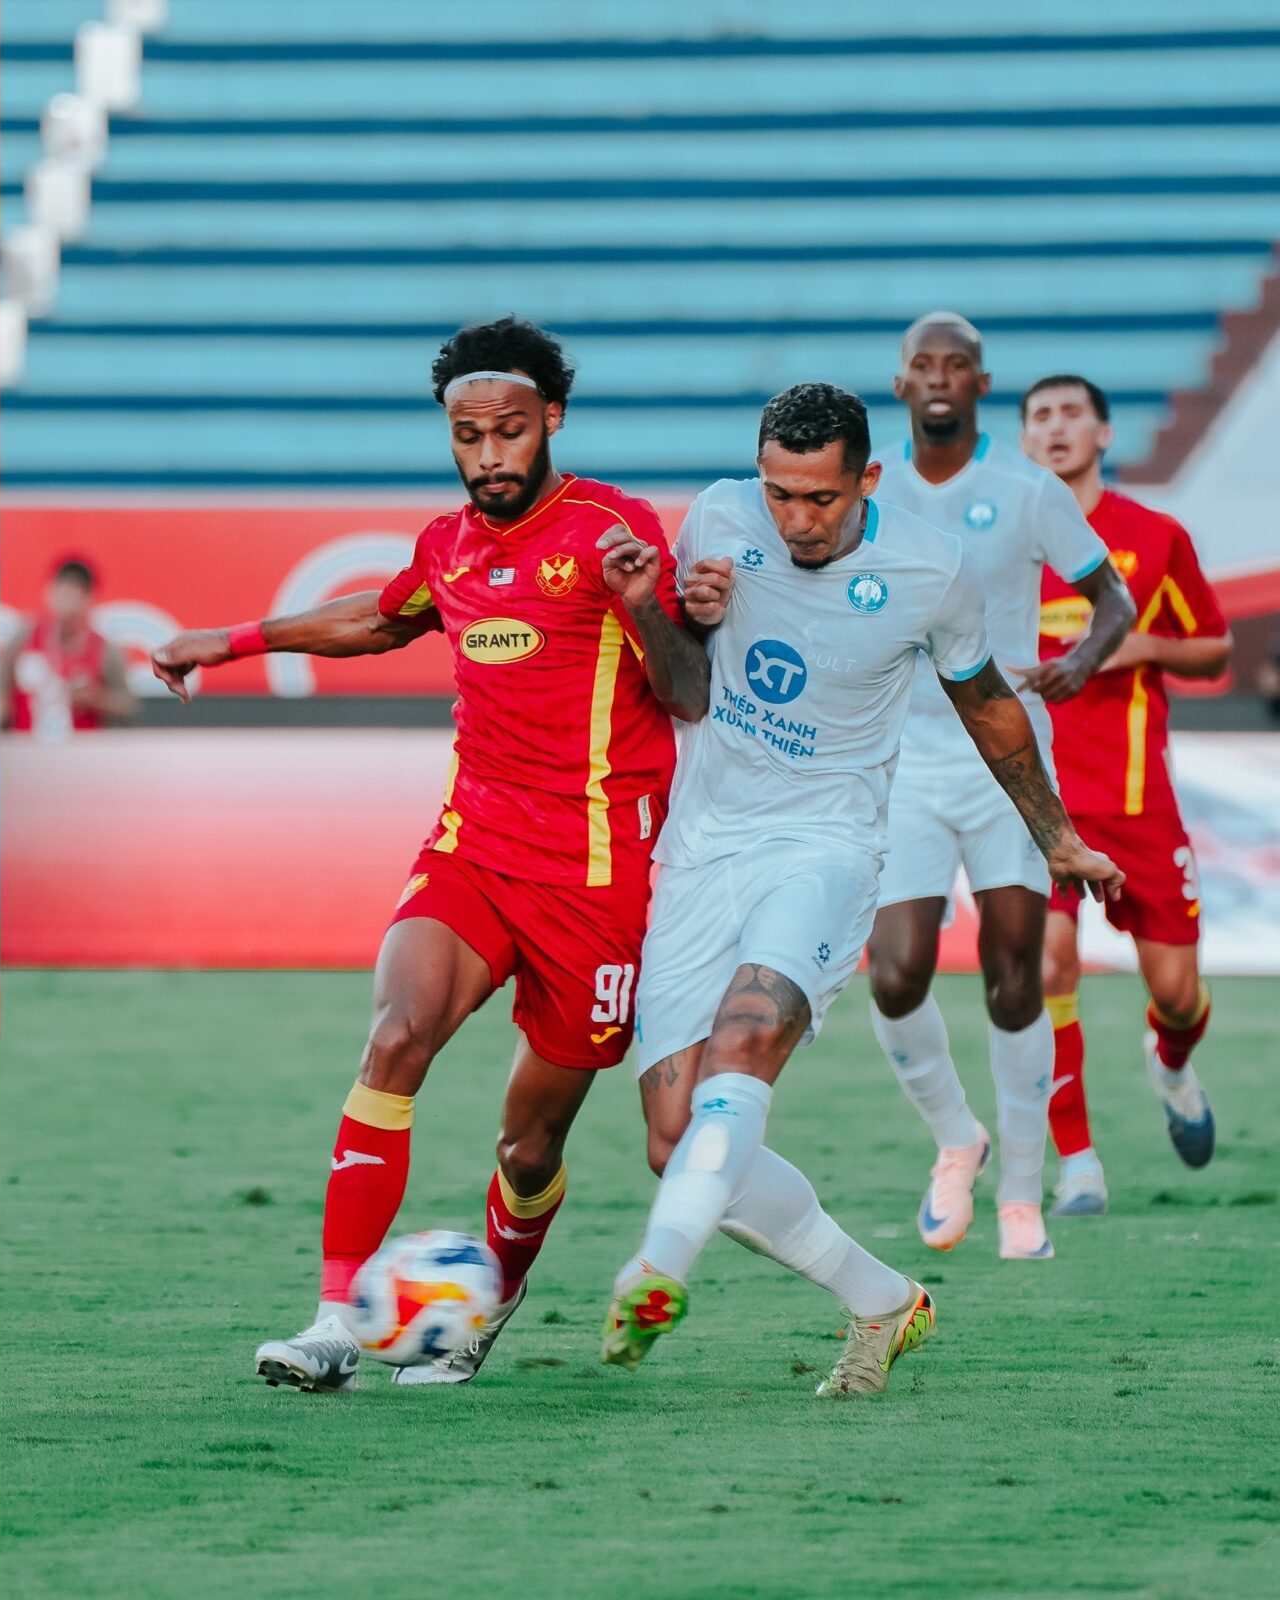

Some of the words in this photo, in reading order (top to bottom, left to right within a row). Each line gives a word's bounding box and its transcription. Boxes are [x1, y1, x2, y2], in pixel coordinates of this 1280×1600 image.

[466, 633, 531, 648] GRANTT
[713, 706, 758, 737] XUÂN
[762, 729, 815, 759] THIỆN
[722, 686, 757, 716] THÉP
[761, 709, 817, 741] XANH
[591, 963, 635, 1024] 91
